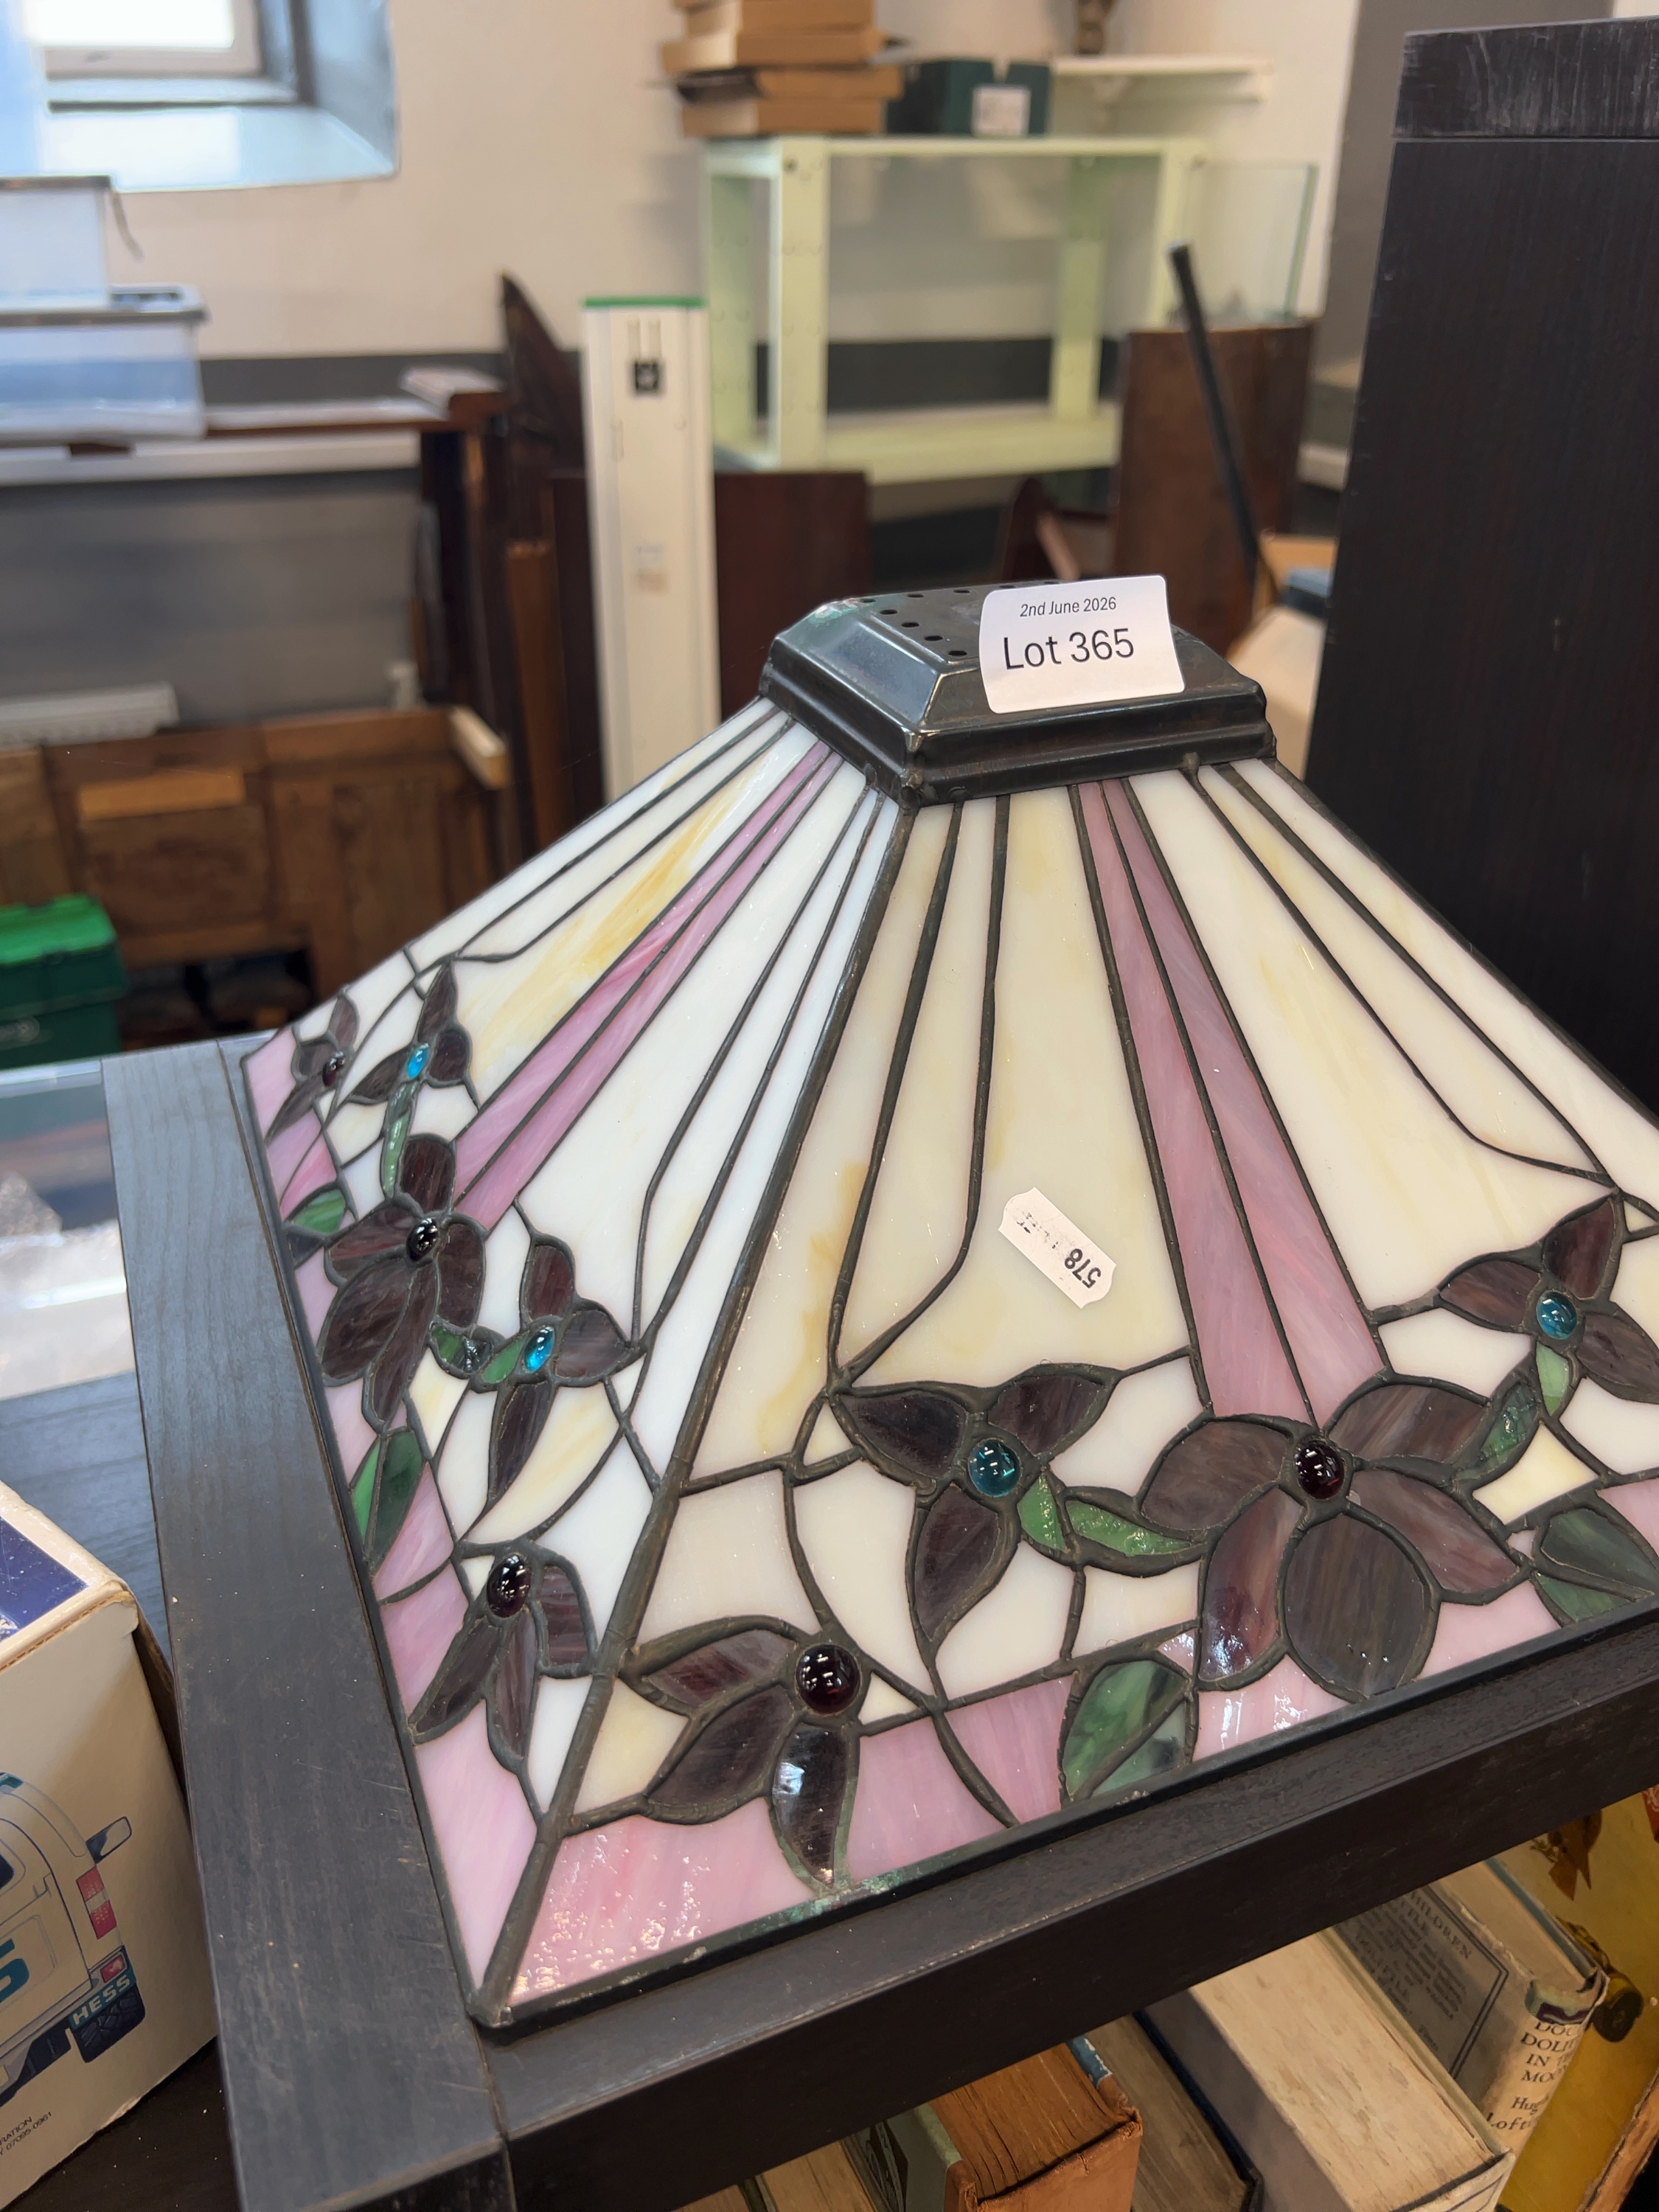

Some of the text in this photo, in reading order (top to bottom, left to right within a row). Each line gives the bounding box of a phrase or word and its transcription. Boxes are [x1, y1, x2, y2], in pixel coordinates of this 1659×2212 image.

[1020, 597, 1116, 617] 2nd June 2026
[1003, 627, 1134, 670] Lot 365
[1064, 1248, 1102, 1289] 578
[73, 1975, 131, 2025] HESS
[1526, 2053, 1551, 2067] IN
